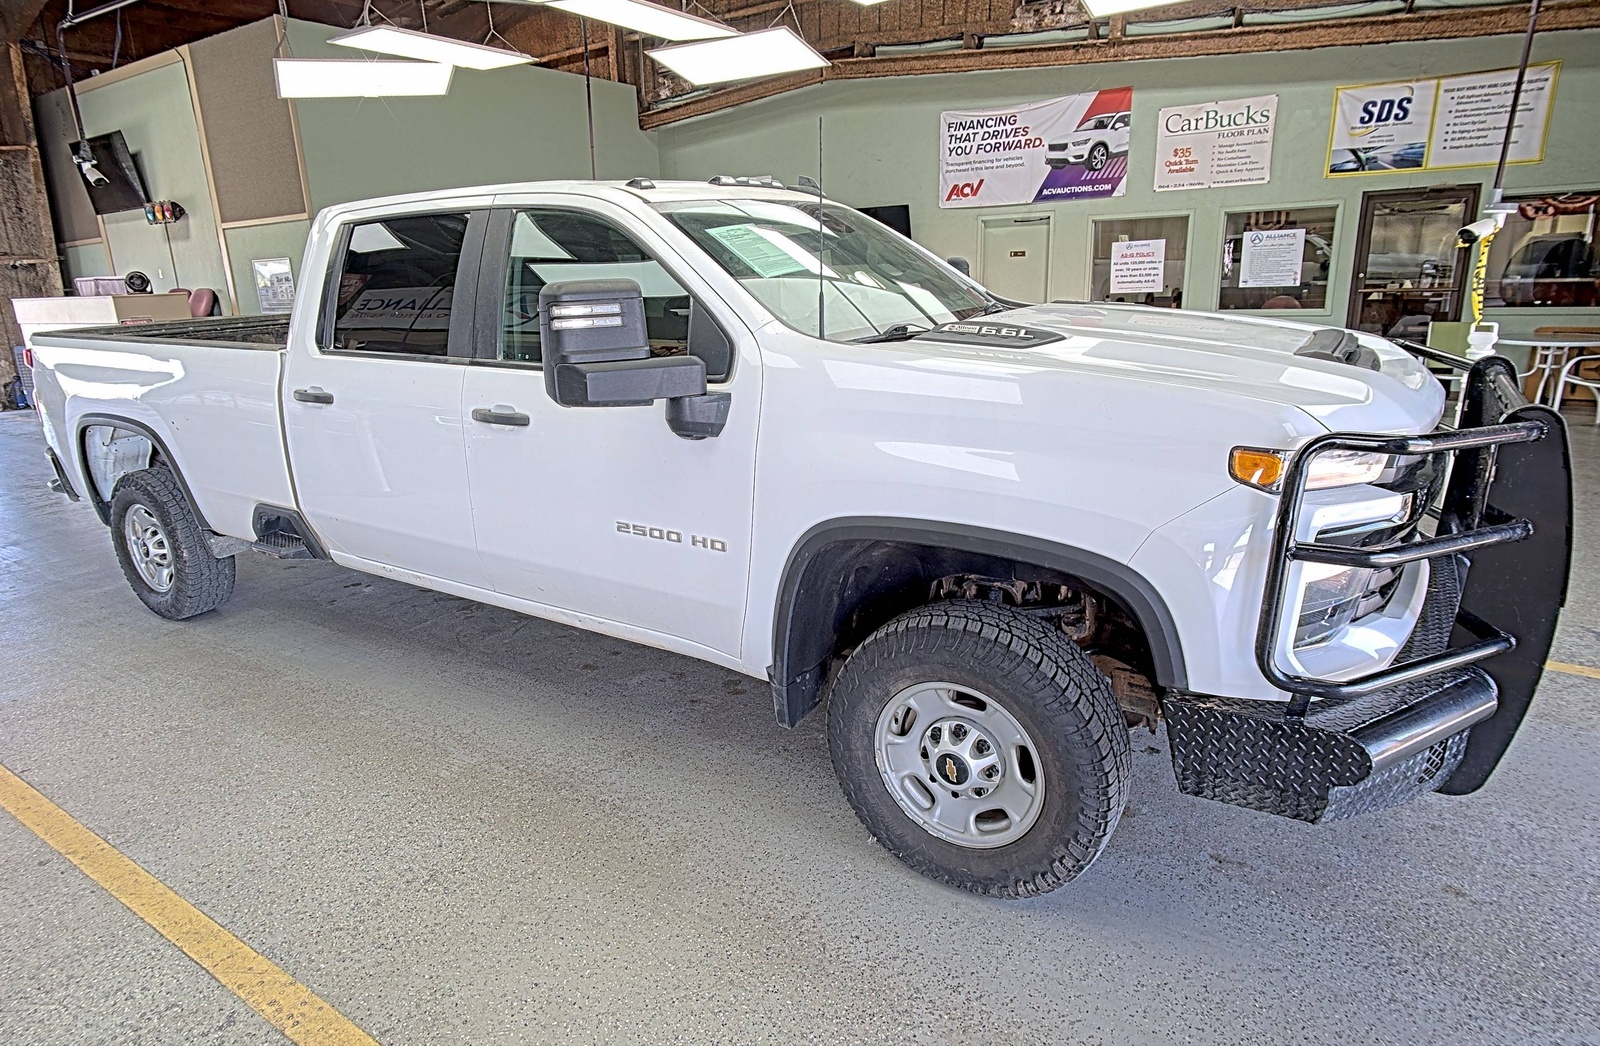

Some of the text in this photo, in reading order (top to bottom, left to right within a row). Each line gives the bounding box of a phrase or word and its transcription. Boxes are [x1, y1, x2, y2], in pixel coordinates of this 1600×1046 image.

[1359, 96, 1413, 124] SDS
[947, 115, 1017, 132] FINANCING
[1166, 105, 1270, 133] CarBucks
[948, 126, 1029, 144] THAT DRIVES
[1217, 127, 1269, 139] FLOOR PLAN
[948, 138, 1045, 156] YOU FORWARD.
[1173, 147, 1192, 158] $35
[1167, 166, 1195, 174] Available
[945, 178, 985, 201] ACV
[1042, 183, 1112, 195] ACVAUCTIONS.COM
[980, 326, 1035, 338] 6.6L
[616, 521, 727, 552] 2500 HD
